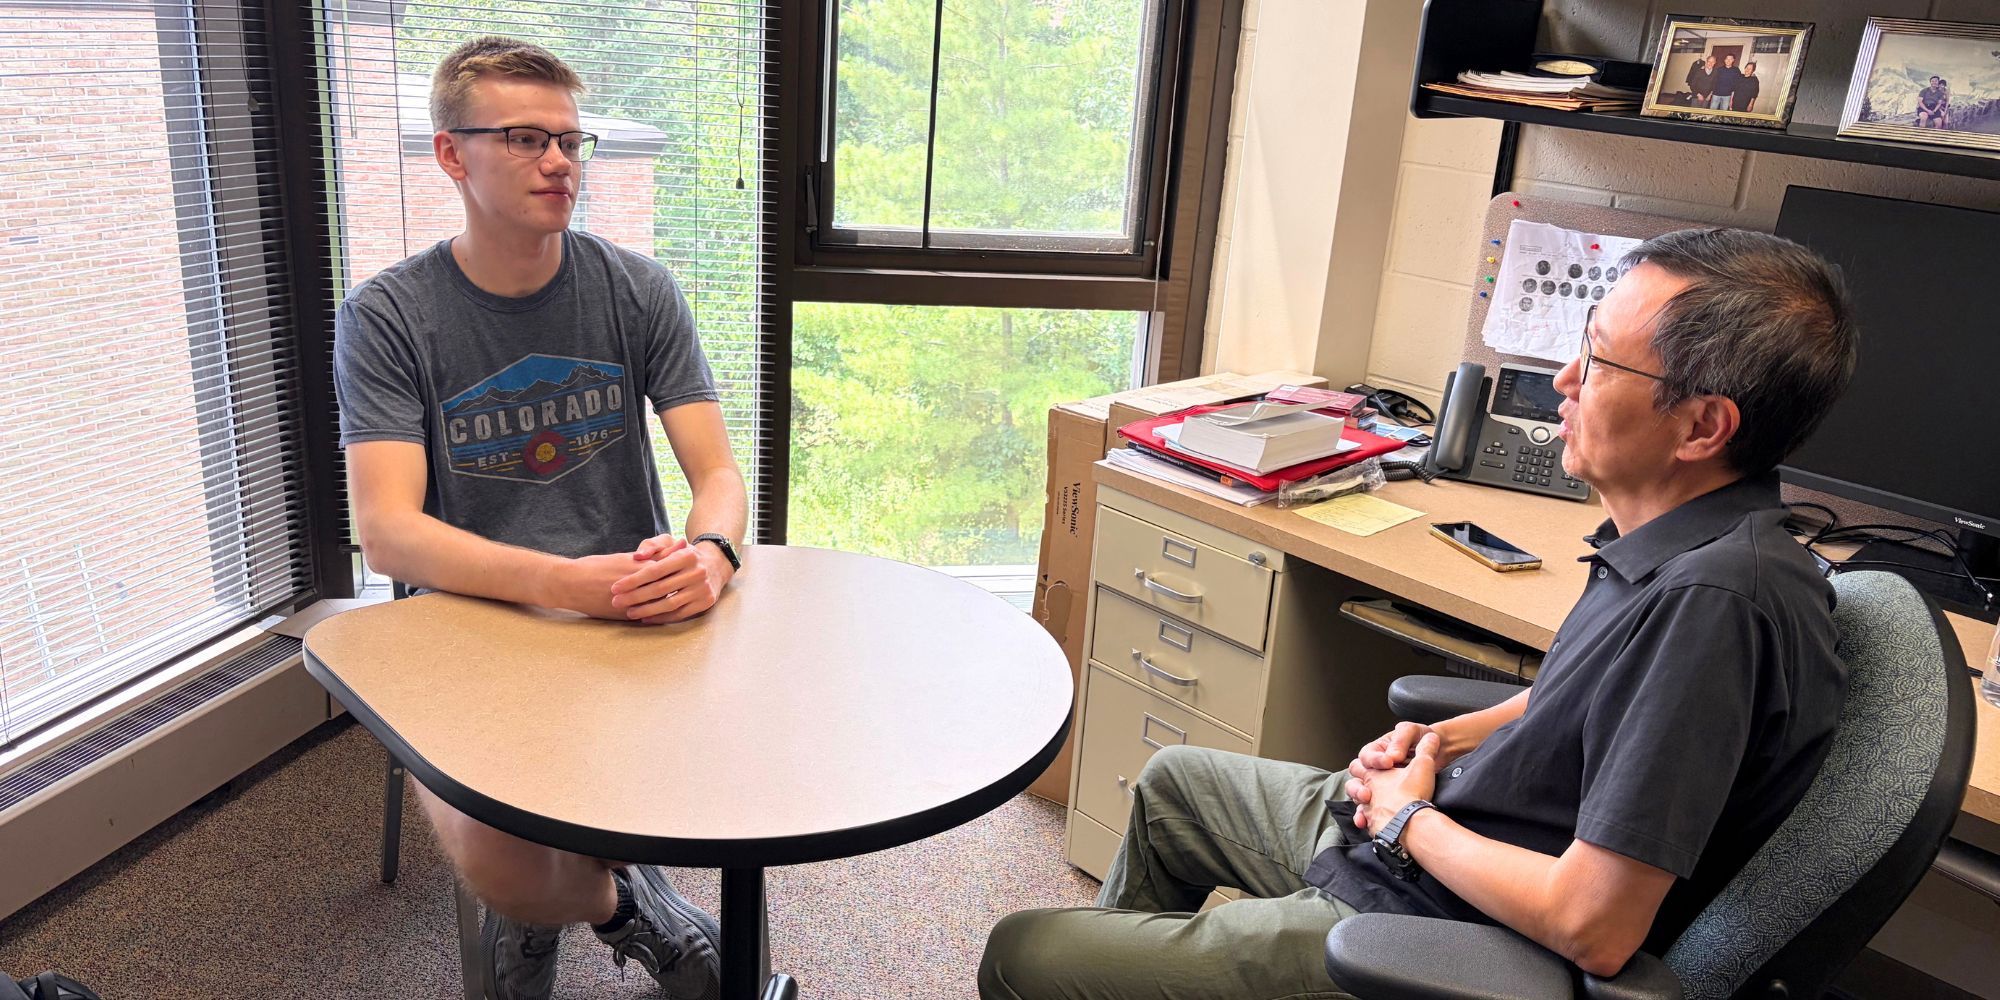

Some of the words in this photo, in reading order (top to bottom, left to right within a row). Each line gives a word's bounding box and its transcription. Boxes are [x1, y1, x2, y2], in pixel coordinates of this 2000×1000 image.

[449, 384, 622, 444] COLORADO
[478, 452, 509, 468] EST
[575, 429, 608, 447] 1876
[1070, 482, 1081, 535] ViewSonic
[1954, 517, 1986, 530] ViewSonic
